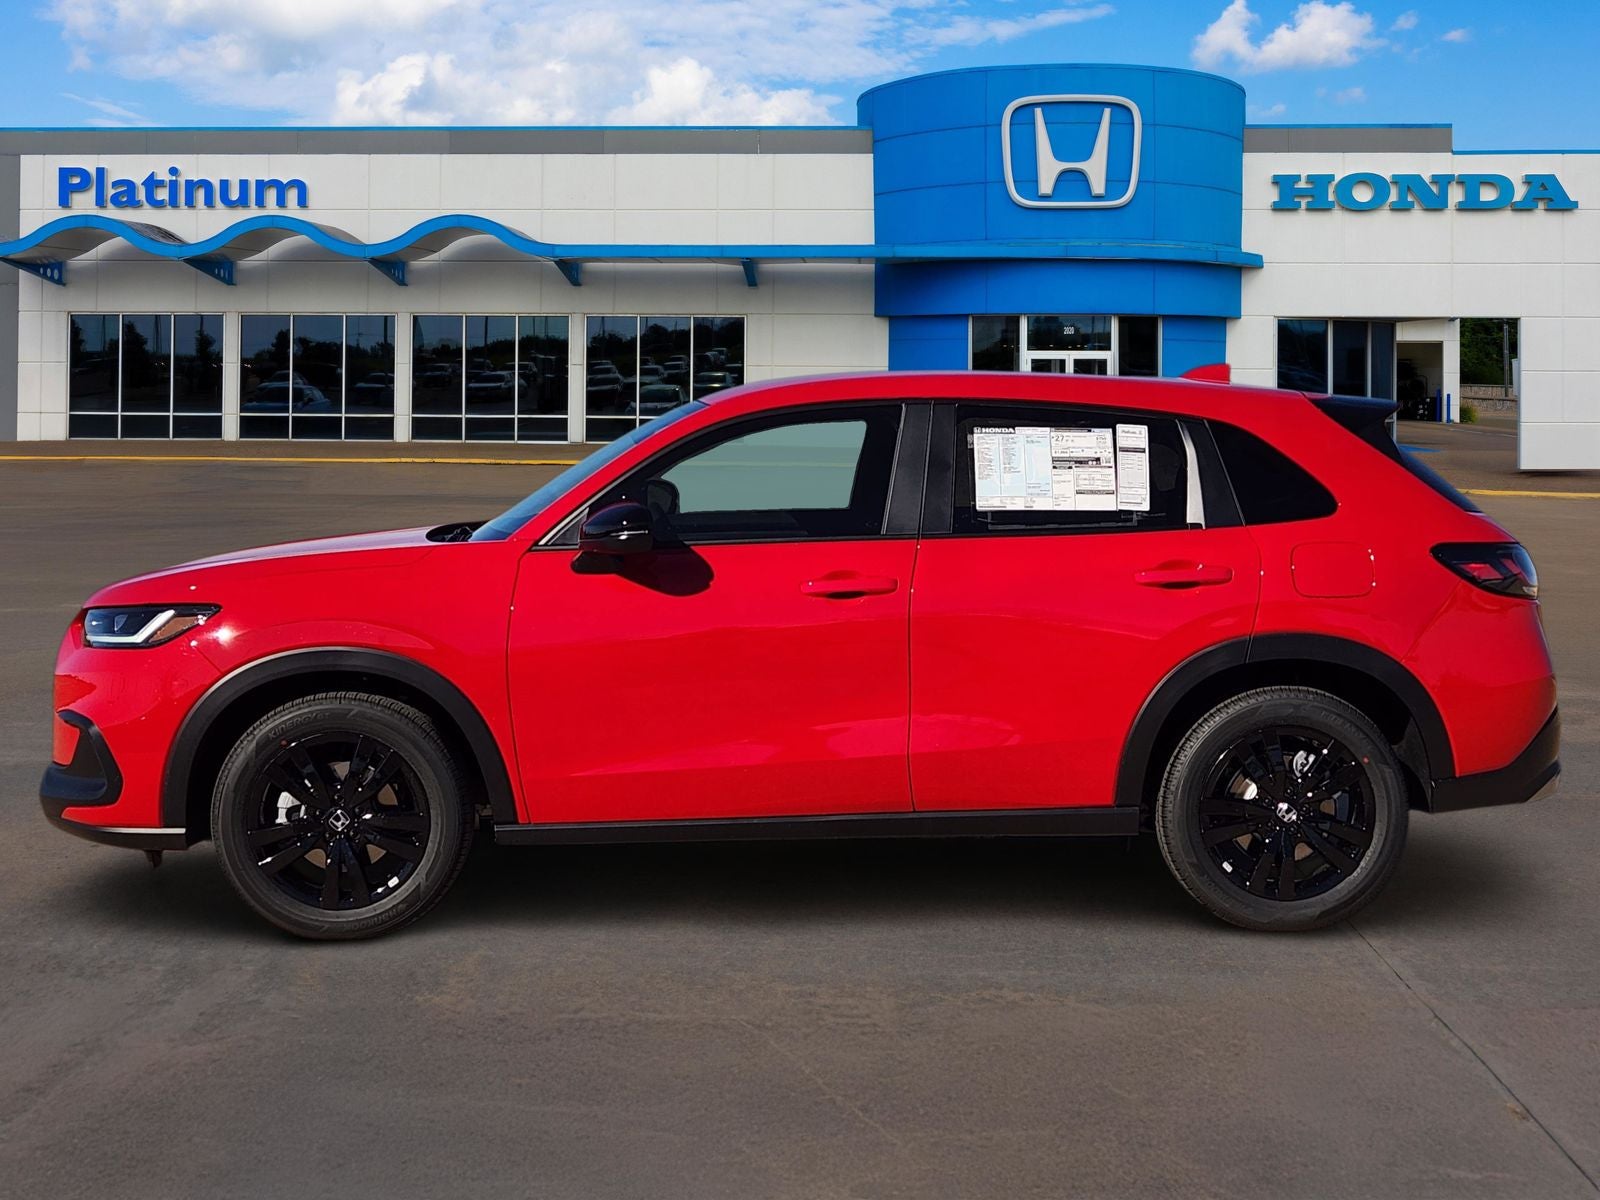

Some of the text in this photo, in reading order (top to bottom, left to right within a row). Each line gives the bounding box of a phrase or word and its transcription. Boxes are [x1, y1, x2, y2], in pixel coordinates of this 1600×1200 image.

[58, 166, 308, 208] Platinum
[1271, 172, 1579, 211] HONDA
[1063, 326, 1075, 335] 2020
[1053, 434, 1065, 442] 27
